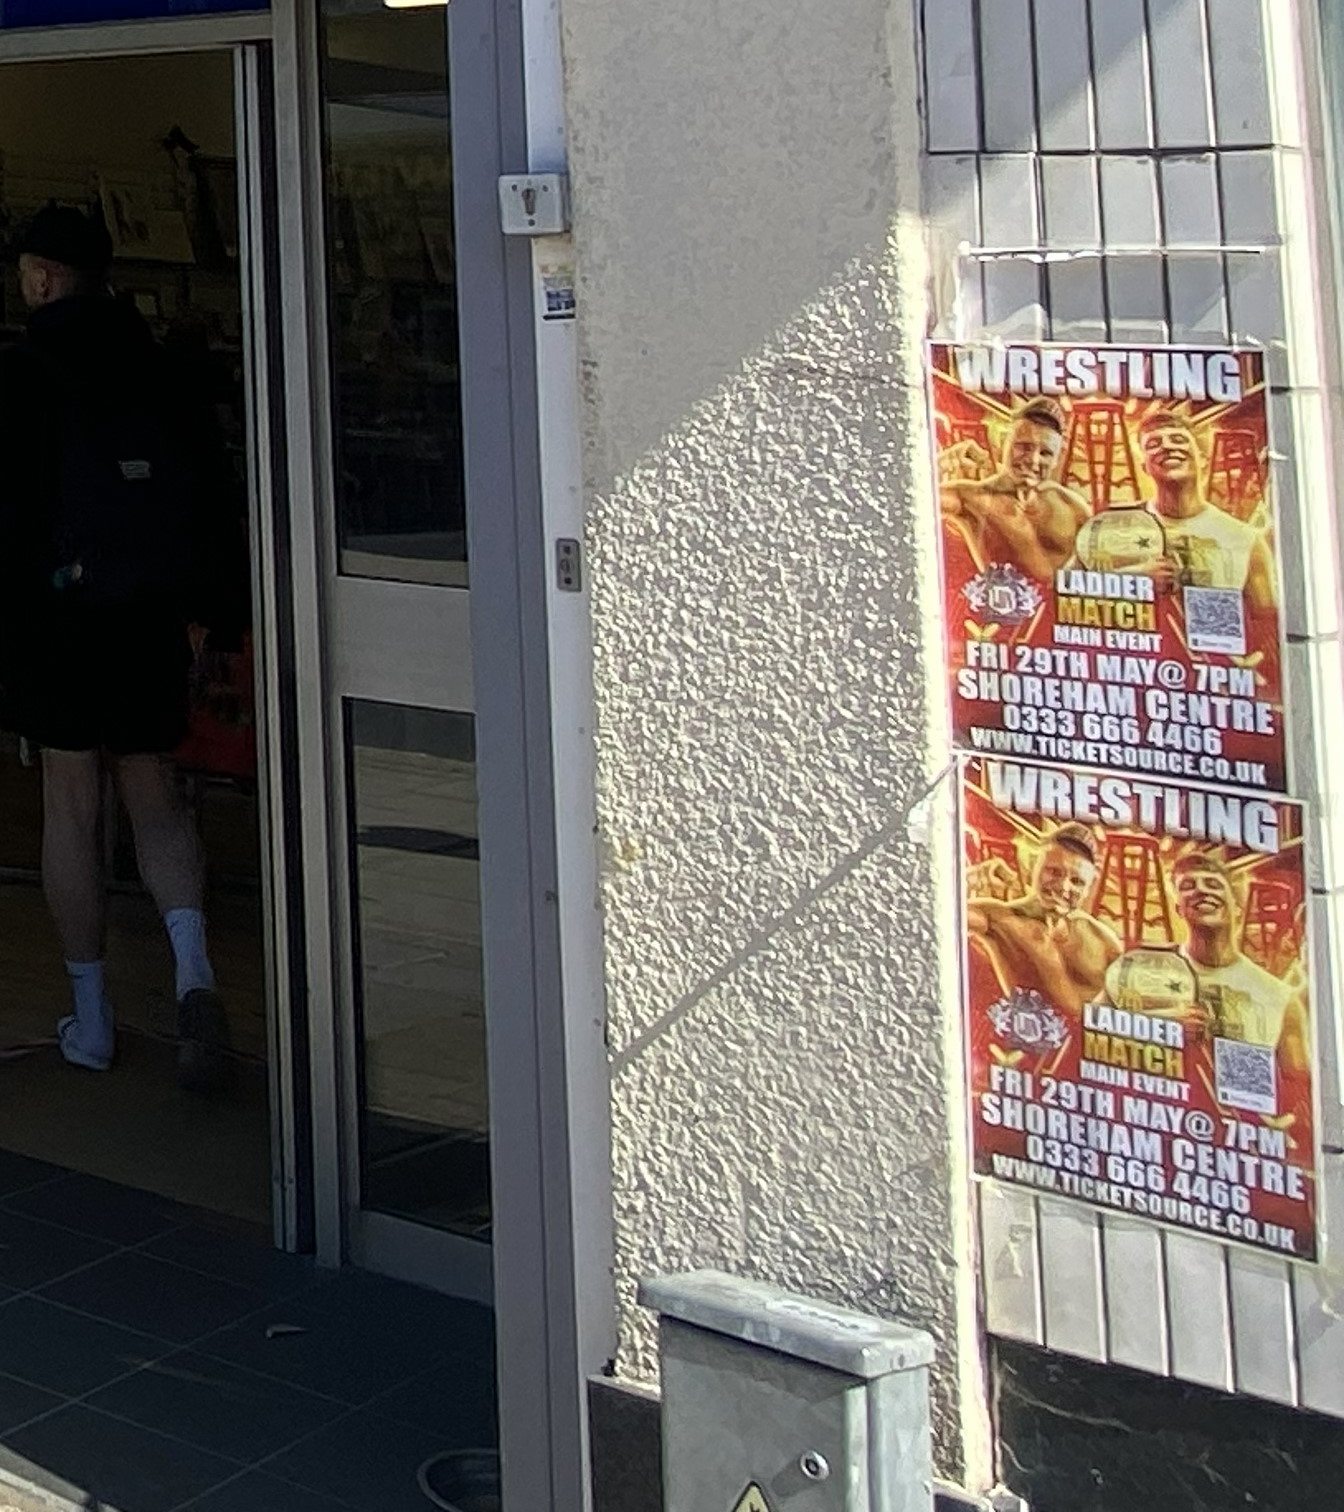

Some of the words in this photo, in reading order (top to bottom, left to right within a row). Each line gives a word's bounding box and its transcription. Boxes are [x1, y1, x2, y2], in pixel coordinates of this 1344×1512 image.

[955, 347, 1242, 403] WRESTLING
[1057, 570, 1154, 601] LADDER
[1057, 596, 1156, 630] MATCH
[1053, 624, 1102, 647] MAIN
[1104, 630, 1163, 653] EVENT
[965, 640, 1009, 670] FRI
[1014, 645, 1090, 679] 29TH
[1192, 663, 1255, 697] 7PM
[957, 669, 1138, 718] SHOREHAM
[1145, 689, 1275, 735] CENTRE
[1003, 705, 1076, 737] 0333
[1082, 713, 1141, 744] 666
[1147, 721, 1223, 755] 4466
[970, 727, 1266, 785] WWW.TICKETSOURCE.CO.UK
[986, 762, 1279, 854] WRESTLING
[1083, 1003, 1184, 1048] LADDER
[1080, 1059, 1129, 1087] MAIN
[1132, 1071, 1190, 1101] EVENT
[1083, 1031, 1184, 1078] MATCH
[990, 1064, 1033, 1099] FRI
[1040, 1076, 1113, 1119] 29TH
[1221, 1118, 1286, 1159] 7PM
[981, 1093, 1162, 1164] SHOREHAM
[1172, 1139, 1305, 1200] CENTRE
[992, 1153, 1296, 1252] WWW.TICKETSOURCE.CO.UK
[1027, 1136, 1099, 1177] 0333
[1107, 1155, 1166, 1192] 666
[1173, 1171, 1251, 1215] 4466
